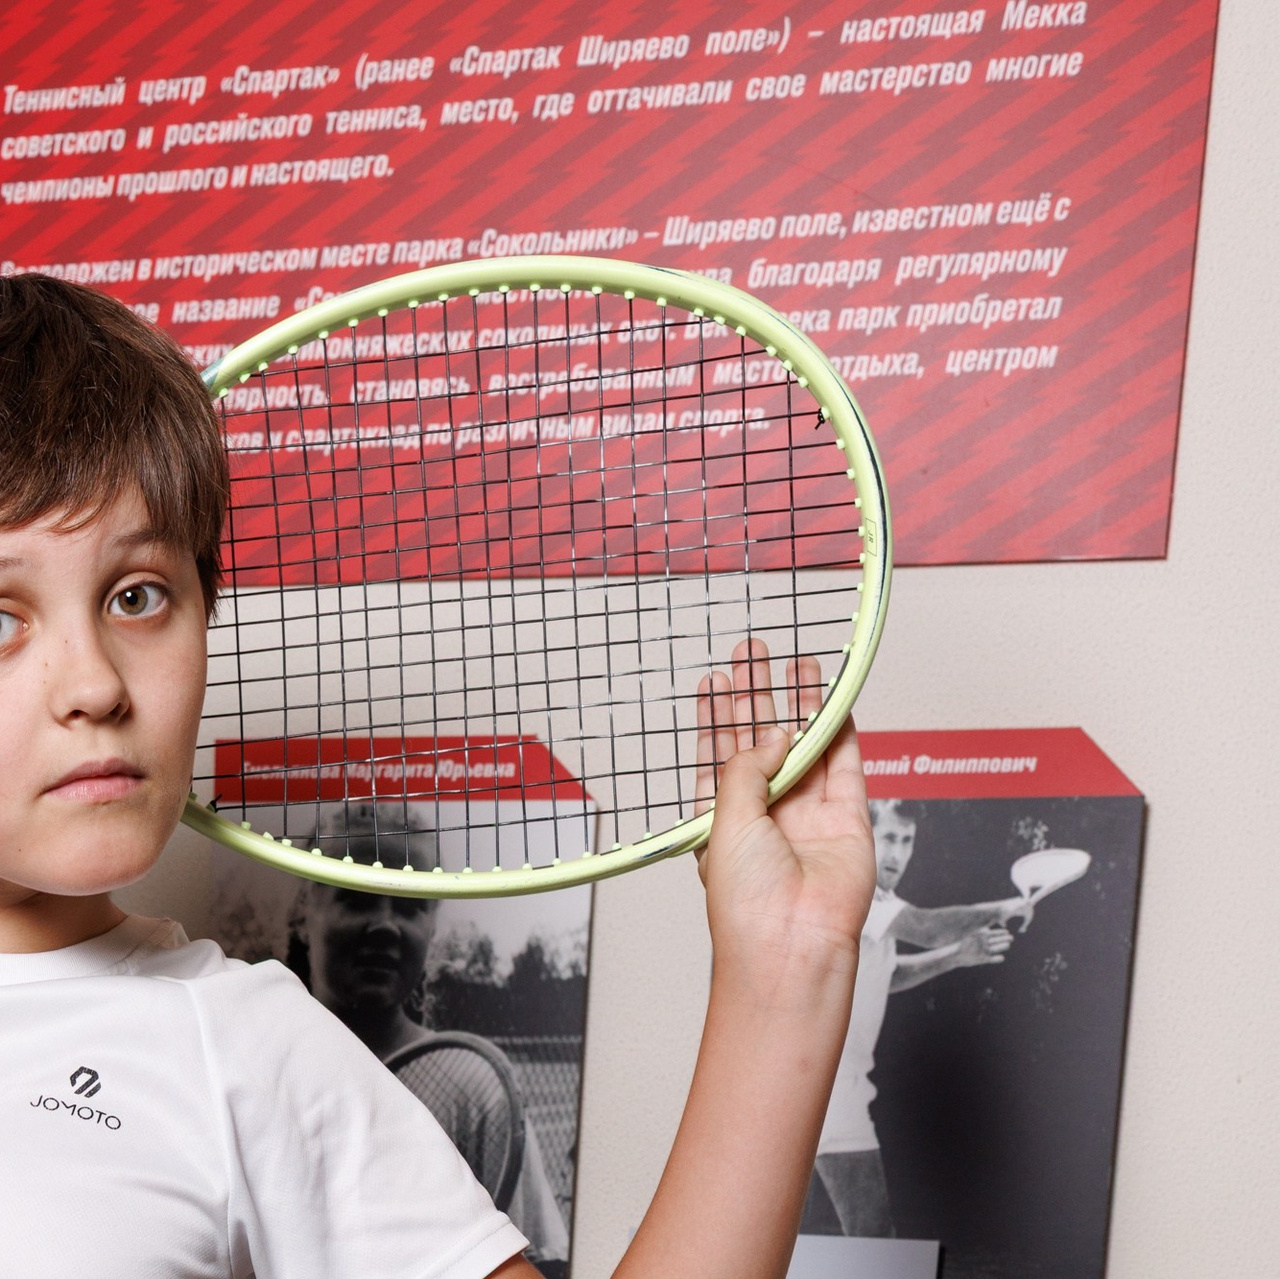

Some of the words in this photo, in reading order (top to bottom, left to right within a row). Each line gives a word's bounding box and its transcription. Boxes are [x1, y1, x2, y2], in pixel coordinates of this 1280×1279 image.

[3, 77, 125, 114] Теннисный
[139, 74, 206, 104] центр
[221, 64, 340, 99] «Спартак»
[355, 53, 434, 89] (ранее
[449, 44, 563, 79] «Спартак
[576, 32, 689, 69] Ширяево
[704, 16, 791, 55] поле»)
[840, 9, 986, 44] настоящая
[1001, 0, 1087, 31] Мекка
[1, 128, 125, 160] советского
[137, 126, 152, 149] и
[163, 112, 312, 153] российского
[325, 104, 427, 134] тенниса,
[440, 96, 520, 126] место,
[533, 92, 574, 120] где
[587, 79, 733, 114] оттачивали
[746, 72, 806, 101] свое
[819, 59, 972, 95] мастерство
[985, 51, 1084, 84] многие
[0, 174, 114, 205] чемпионы
[116, 165, 228, 201] прошлого
[232, 165, 247, 188] и
[251, 152, 393, 186] настоящего.
[137, 258, 152, 280] в
[154, 246, 317, 283] историческом
[320, 240, 389, 268] месте
[393, 237, 463, 267] парка
[467, 226, 638, 257] «Сокольники»
[663, 215, 777, 249] Ширяево
[780, 211, 847, 240] поле,
[853, 202, 993, 234] известном
[996, 192, 1052, 226] ещё
[1054, 196, 1071, 221] с
[172, 294, 281, 324] название
[748, 257, 882, 289] благодаря
[895, 247, 1068, 286] регулярному
[837, 304, 901, 335] парк
[906, 293, 1062, 329] приобретал
[831, 351, 924, 382] отдыха,
[945, 344, 1057, 377] центром
[913, 755, 1037, 775] Филиппович
[30, 1095, 122, 1130] JOMOTO
